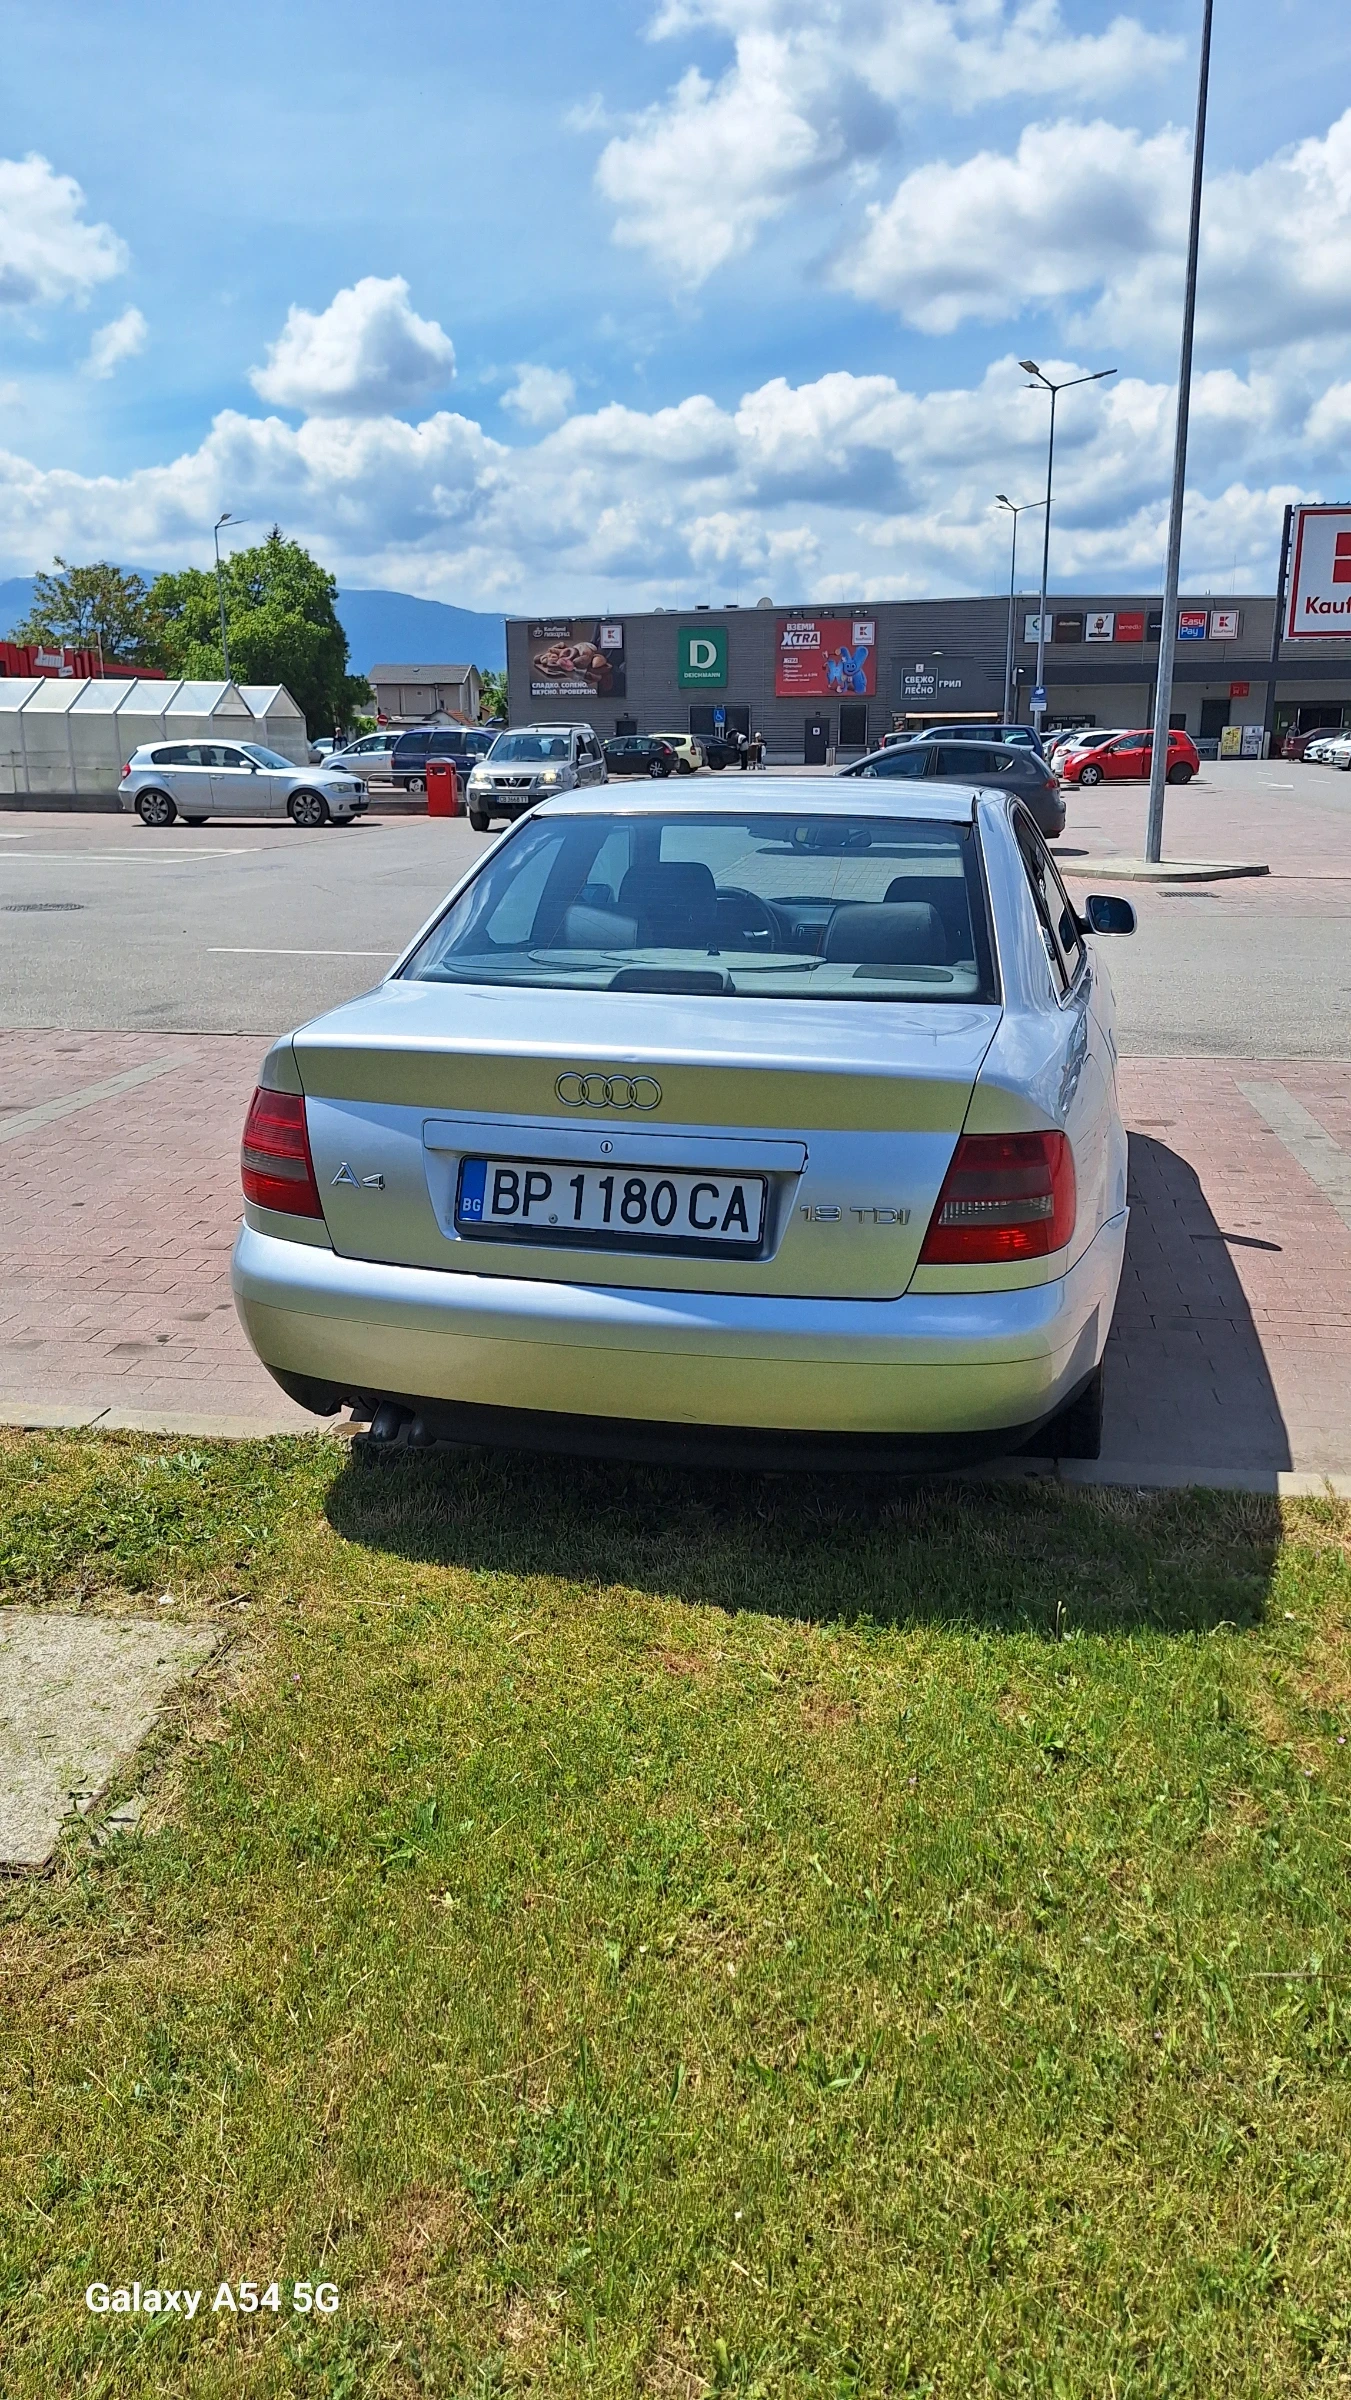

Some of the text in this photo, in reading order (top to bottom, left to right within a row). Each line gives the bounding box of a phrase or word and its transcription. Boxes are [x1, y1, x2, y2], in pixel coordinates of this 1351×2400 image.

[786, 623, 815, 631] ВЗЕМИ
[1181, 617, 1205, 627] Easy
[781, 631, 820, 646] XTRA
[1181, 627, 1199, 637] Pay
[689, 639, 717, 669] D
[938, 680, 962, 688] ГРИЛ
[330, 1161, 385, 1191] A4
[462, 1197, 482, 1212] BG
[491, 1169, 749, 1232] BP 1180 CA
[850, 1206, 911, 1225] TDI
